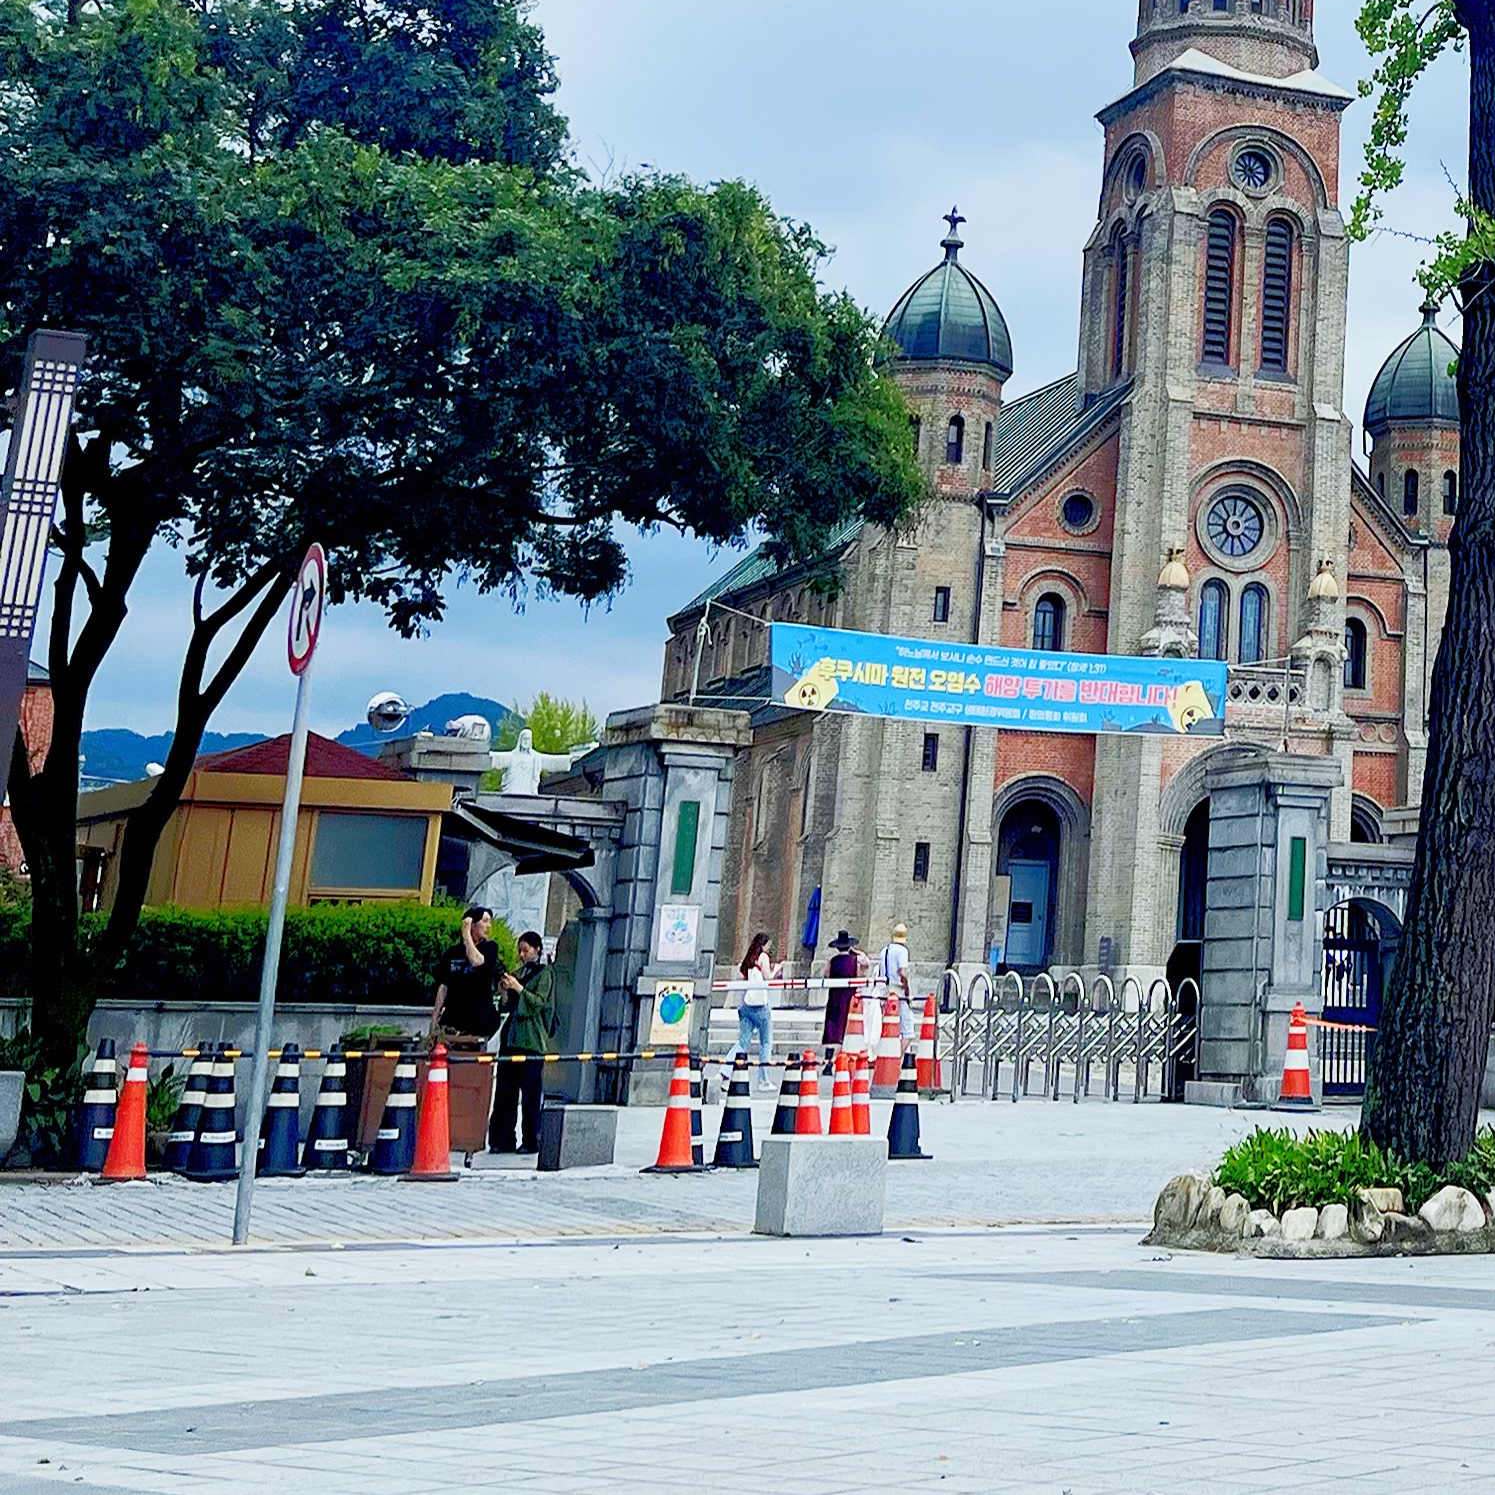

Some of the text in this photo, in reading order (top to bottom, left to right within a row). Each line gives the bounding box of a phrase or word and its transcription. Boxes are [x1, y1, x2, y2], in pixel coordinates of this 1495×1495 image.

[818, 656, 1177, 708] 후쿠시마 원전 오염수 해양 투기를 반대합니다!
